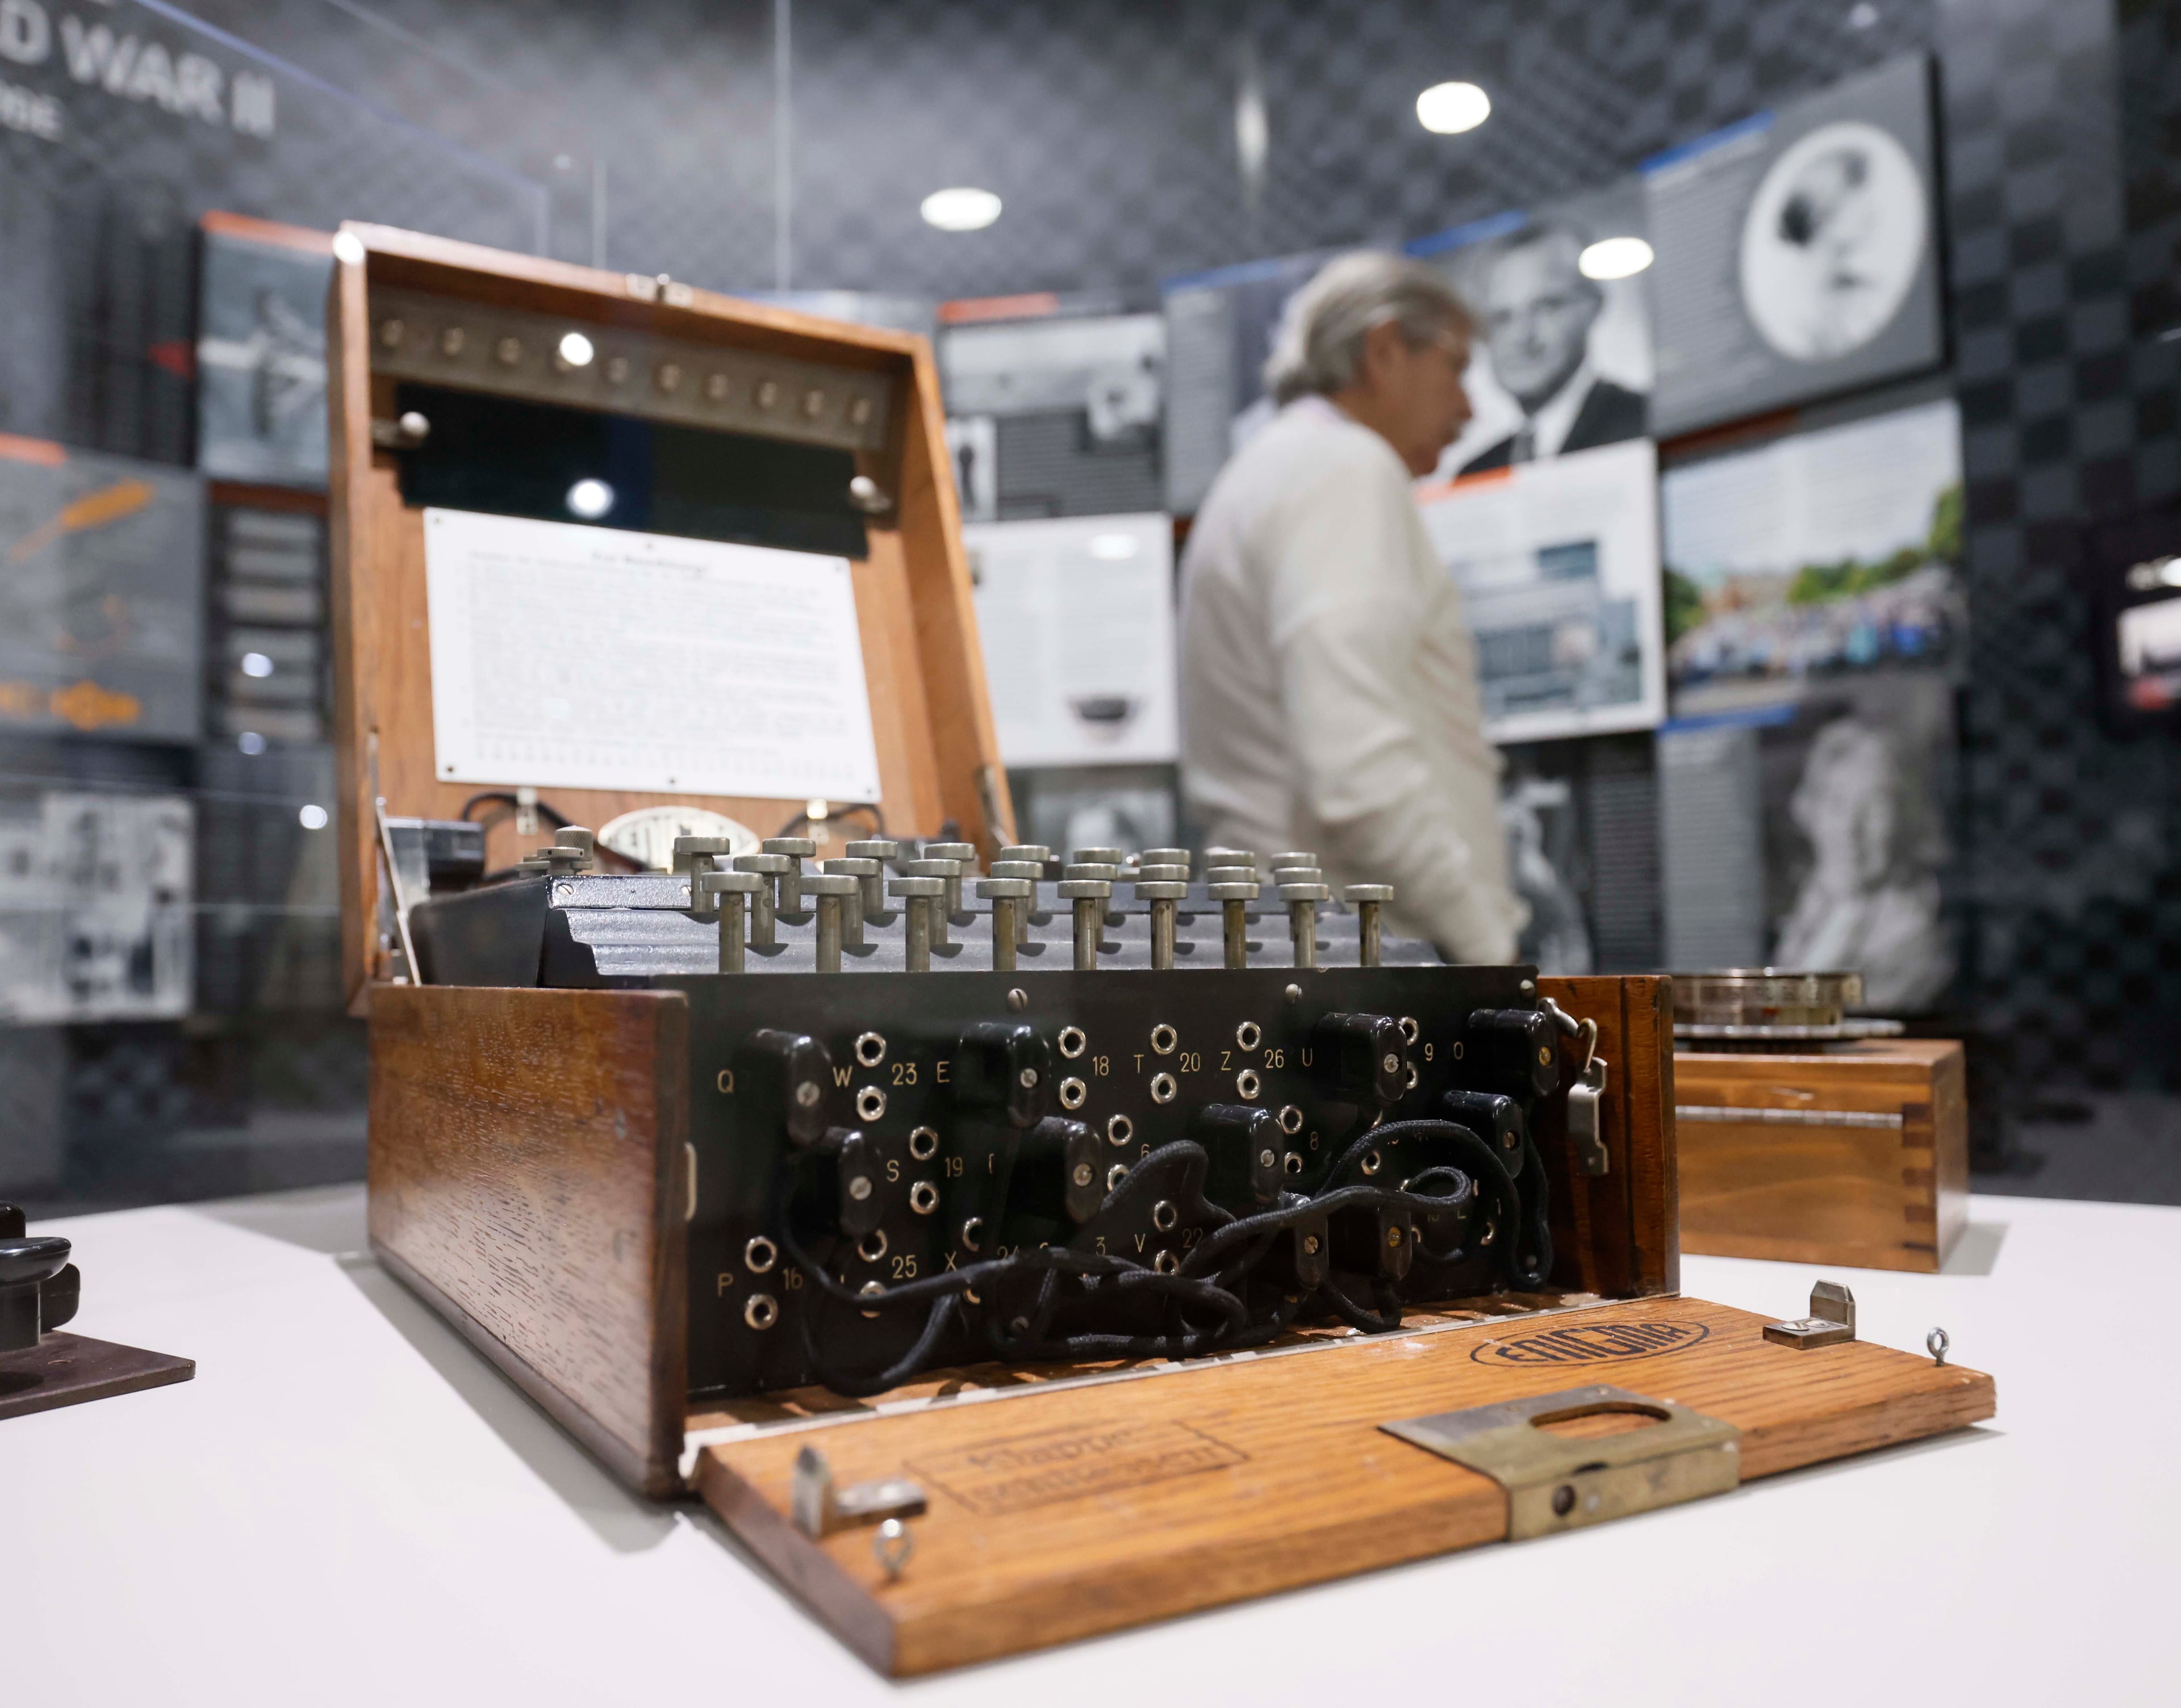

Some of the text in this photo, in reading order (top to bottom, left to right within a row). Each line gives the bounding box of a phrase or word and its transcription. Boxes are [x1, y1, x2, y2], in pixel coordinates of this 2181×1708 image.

[60, 15, 225, 125] WAR
[717, 1069, 733, 1093] Q
[833, 1065, 853, 1087] W
[892, 1062, 917, 1086] 23
[937, 1061, 950, 1083] E
[1092, 1055, 1109, 1076] 18
[1133, 1054, 1144, 1073] T
[1180, 1052, 1201, 1073] 20
[1221, 1050, 1231, 1071] Z
[1264, 1049, 1284, 1069] 26
[1302, 1048, 1313, 1067] U
[887, 1159, 900, 1182] S
[945, 1156, 963, 1178] 19
[1310, 1131, 1318, 1151] 8
[717, 1272, 734, 1297] P
[783, 1268, 803, 1290] 16
[892, 1254, 917, 1279] 25
[946, 1251, 958, 1270] X
[1096, 1236, 1106, 1256] 3
[1134, 1233, 1146, 1253] V
[1494, 1323, 1691, 1362] ENIGMA
